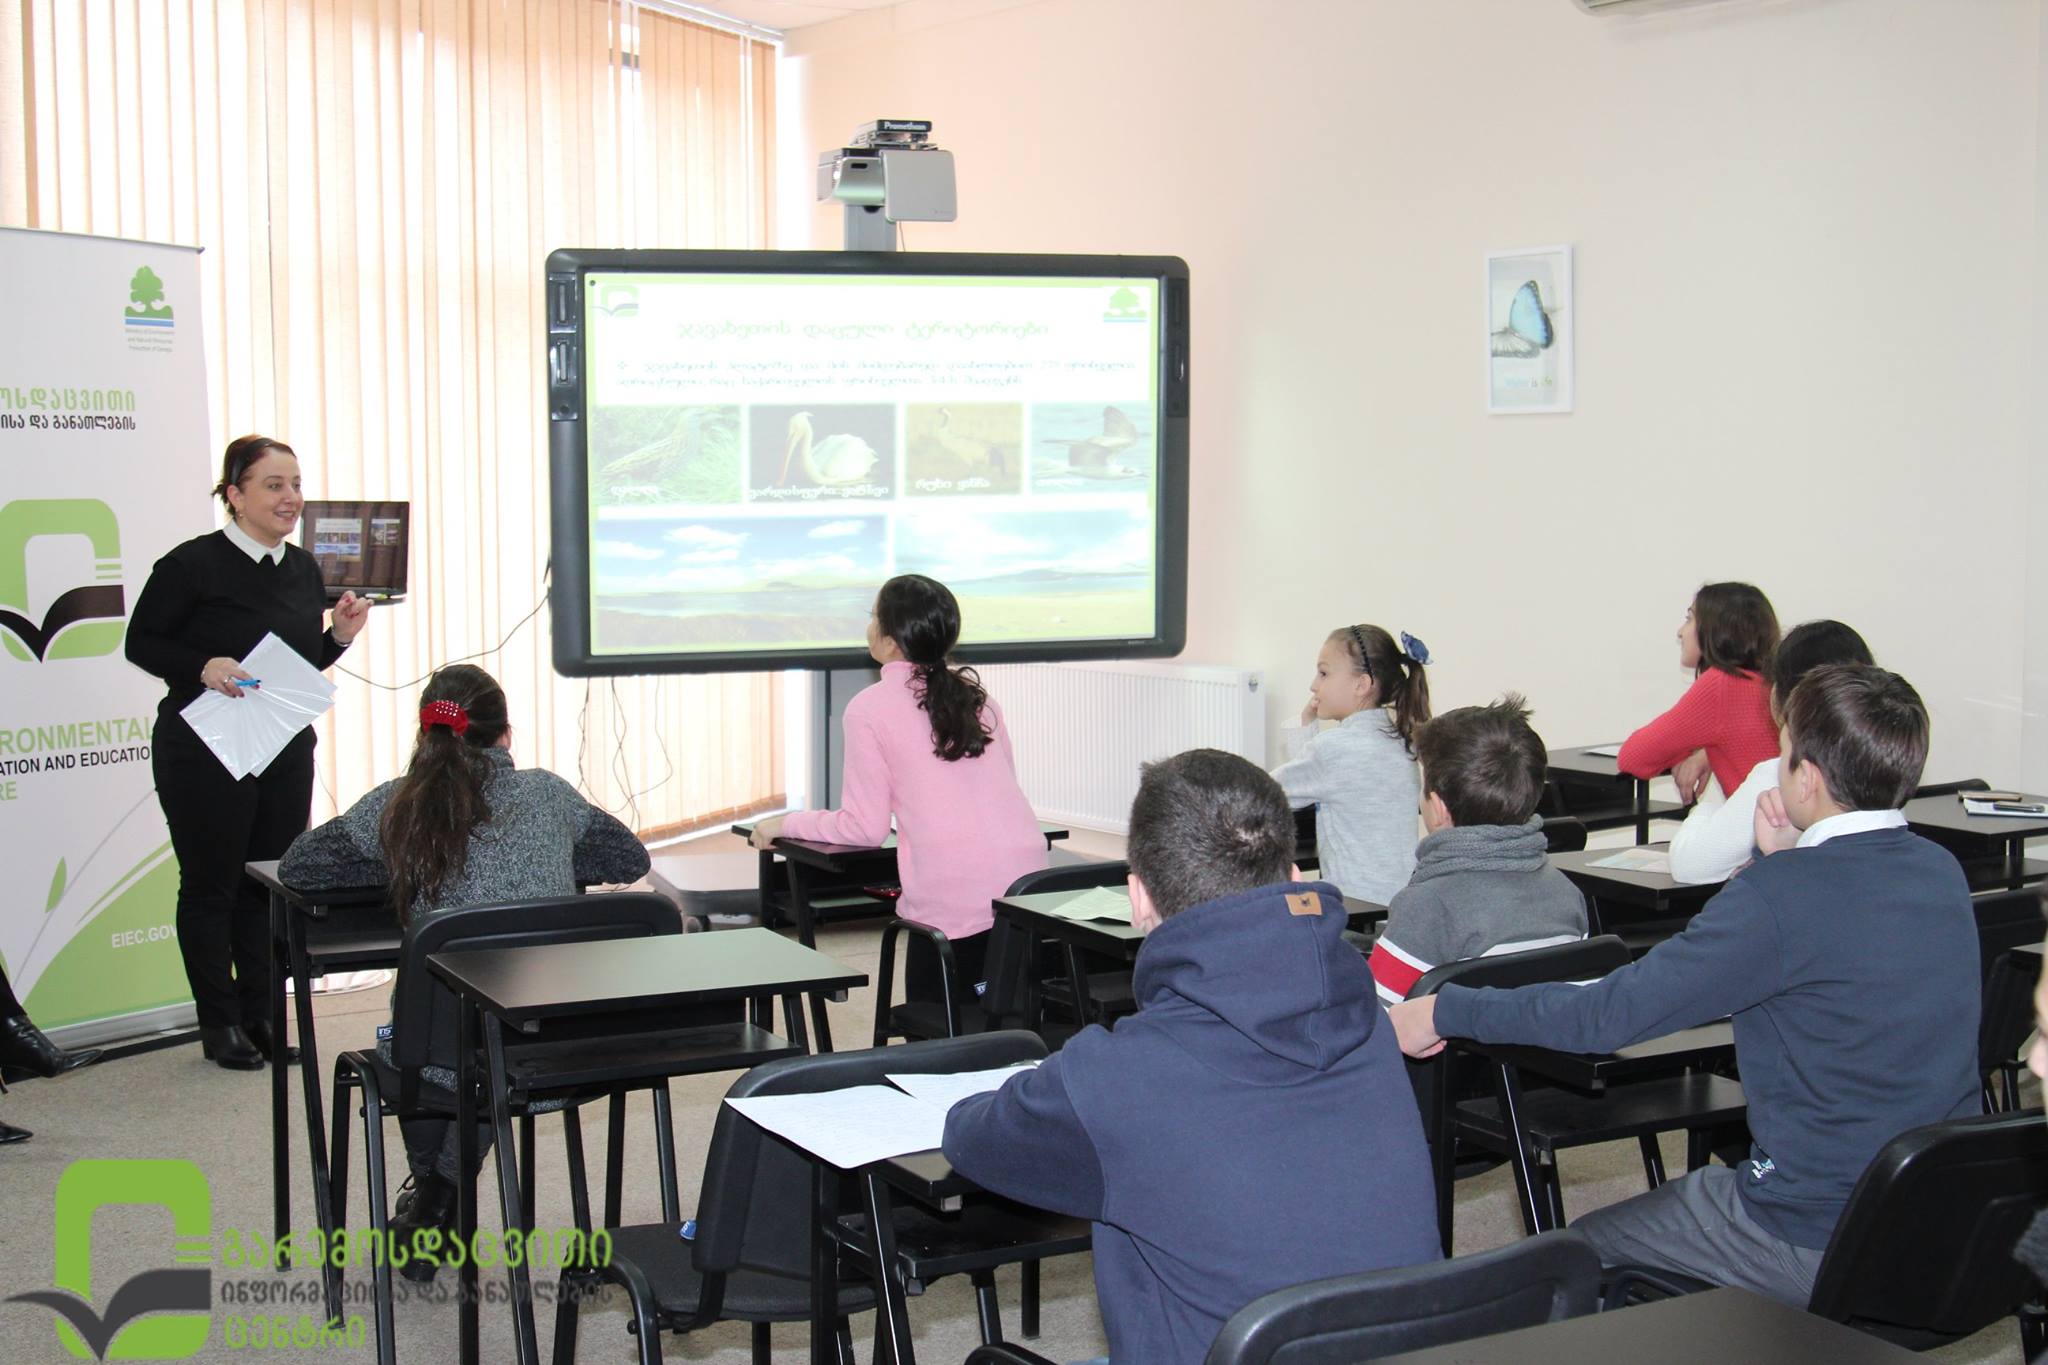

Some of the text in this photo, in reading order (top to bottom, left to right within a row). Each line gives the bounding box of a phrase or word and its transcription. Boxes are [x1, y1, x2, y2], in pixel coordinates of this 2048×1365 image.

[29, 414, 49, 429] და
[53, 415, 136, 430] განათლების
[45, 754, 76, 771] AND
